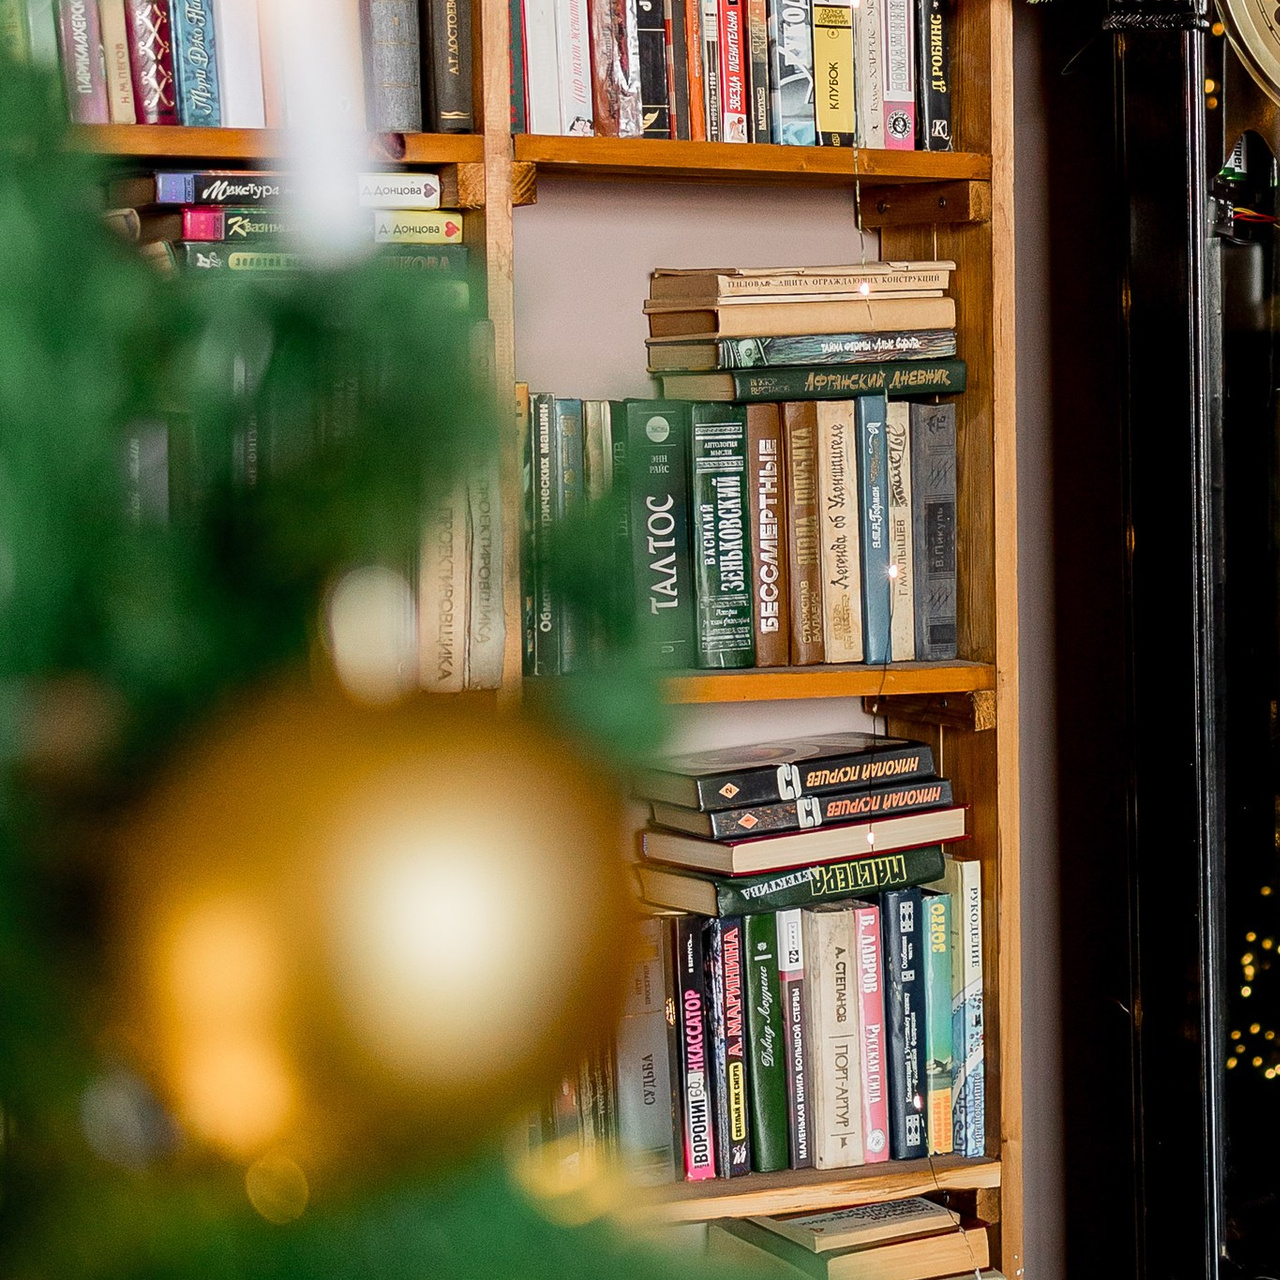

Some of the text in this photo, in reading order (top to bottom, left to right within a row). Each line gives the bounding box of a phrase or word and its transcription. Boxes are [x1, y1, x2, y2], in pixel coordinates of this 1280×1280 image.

[189, 27, 209, 69] Джо
[570, 44, 582, 76] полон
[726, 10, 742, 112] ЗВЕЗДА ПЛЕНИТЕЛЬНА
[866, 28, 877, 80] ХАРРИС
[929, 14, 947, 94] Д.РОБИНС
[828, 61, 839, 110] КЛУБОК
[374, 185, 422, 197] Донцова
[393, 223, 441, 235] Донцова
[881, 273, 940, 284] КОНСТРУКЦИЙ
[804, 368, 952, 392] АФГАНСКИЙ ДНЕВНИК
[538, 404, 550, 454] машин
[651, 454, 668, 463] ЭНН
[649, 463, 669, 474] РАЙС
[827, 423, 845, 509] Уленшпигеле
[700, 503, 716, 566] ВАСИЛИЙ
[712, 475, 746, 593] ЗЕНЬКОВСКИЙ
[758, 438, 780, 634] БЕССМЕРТНЫЕ
[830, 515, 847, 529] об
[933, 507, 945, 568] В.Пикуль
[645, 493, 679, 615] ТАЛТОС
[829, 534, 850, 590] Легенда
[800, 580, 812, 644] СТАНИСЛАВ
[806, 756, 920, 788] НИКОЛАЙ ПСУРЦЕВ
[826, 787, 942, 817] НИКОЛАЙ ПСУРЦЕВ
[740, 854, 907, 901] МАСТЕРА ДЕТЕКТИВА
[860, 914, 878, 993] В. ЛАВРОВ
[930, 903, 946, 954] ЗОРРО
[970, 886, 980, 968] РУКОДЕЛИЕ
[724, 928, 744, 1057] А. МАРИНИНА
[835, 946, 848, 1023] А. СТЕПАНОВ
[756, 966, 775, 1067] Дэвид Лоуренс
[642, 1054, 657, 1106] СУДЬБА
[791, 988, 808, 1160] МАЛЕНЬКАЯ КНИГА БОЛЬШОЙ СТЕРВЫ
[834, 1044, 850, 1128] ПОРТ-АРТУР
[866, 1023, 882, 1104] РУССКАЯ СИЛА
[732, 1065, 743, 1139] СВЕТЛЫЙ ЛИК СМЕРТИ
[973, 1073, 983, 1148] ЭНЦИКЛОПЕДИЯ
